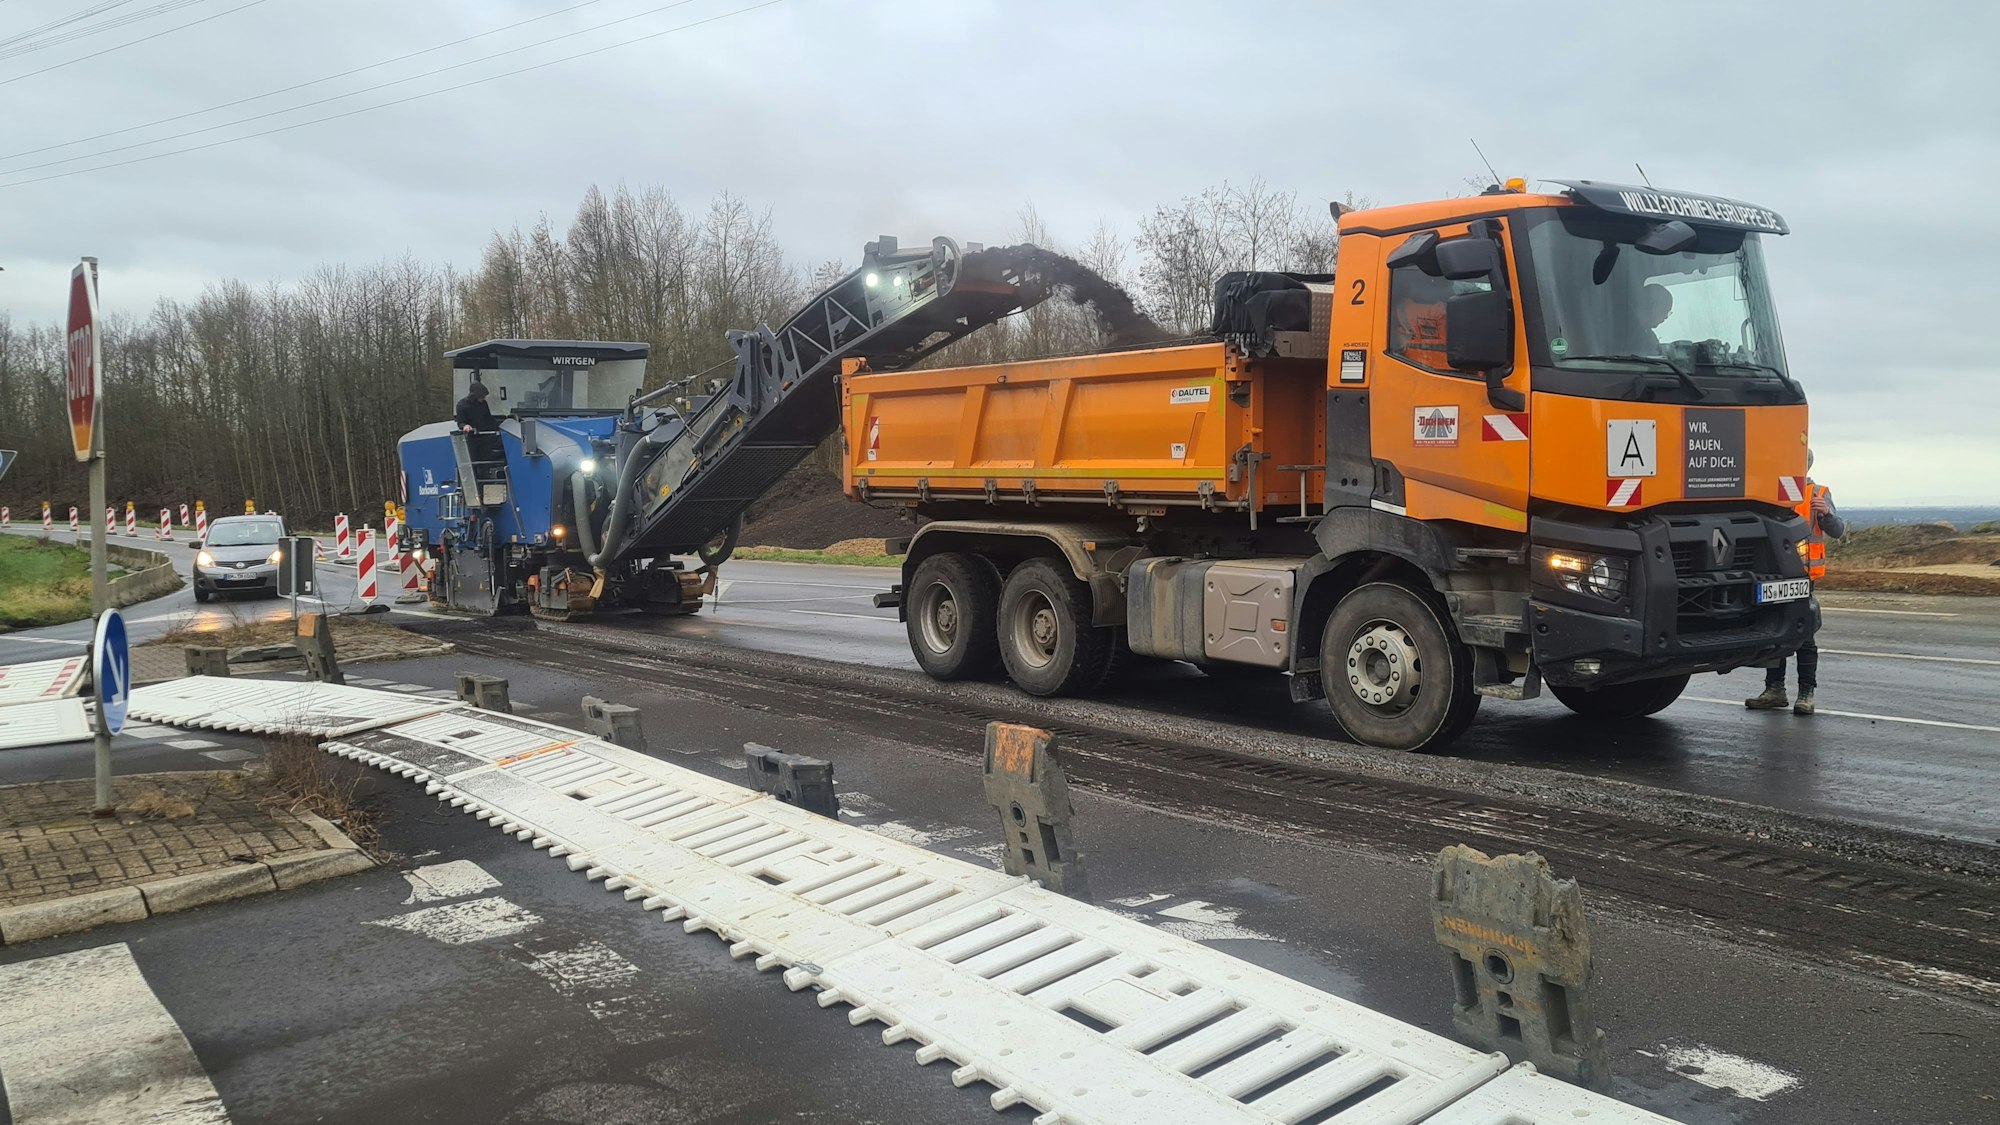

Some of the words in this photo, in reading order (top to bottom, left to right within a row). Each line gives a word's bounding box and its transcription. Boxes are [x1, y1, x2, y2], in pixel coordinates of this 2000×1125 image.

[1619, 191, 1782, 231] WILLY-DOHMEN-GRUPPE.DE
[1351, 279, 1366, 305] 2
[69, 324, 91, 400] STOP
[552, 356, 596, 366] WIRTGEN
[1178, 387, 1209, 397] DAUTEL
[1688, 422, 1711, 434] WIR.
[1620, 427, 1645, 467] A
[1688, 439, 1724, 451] BAUEN.
[1688, 456, 1708, 468] AUF
[1710, 456, 1737, 468] DICH.
[1763, 585, 1773, 600] HS
[1778, 583, 1789, 598] WD
[1790, 581, 1809, 597] 5302
